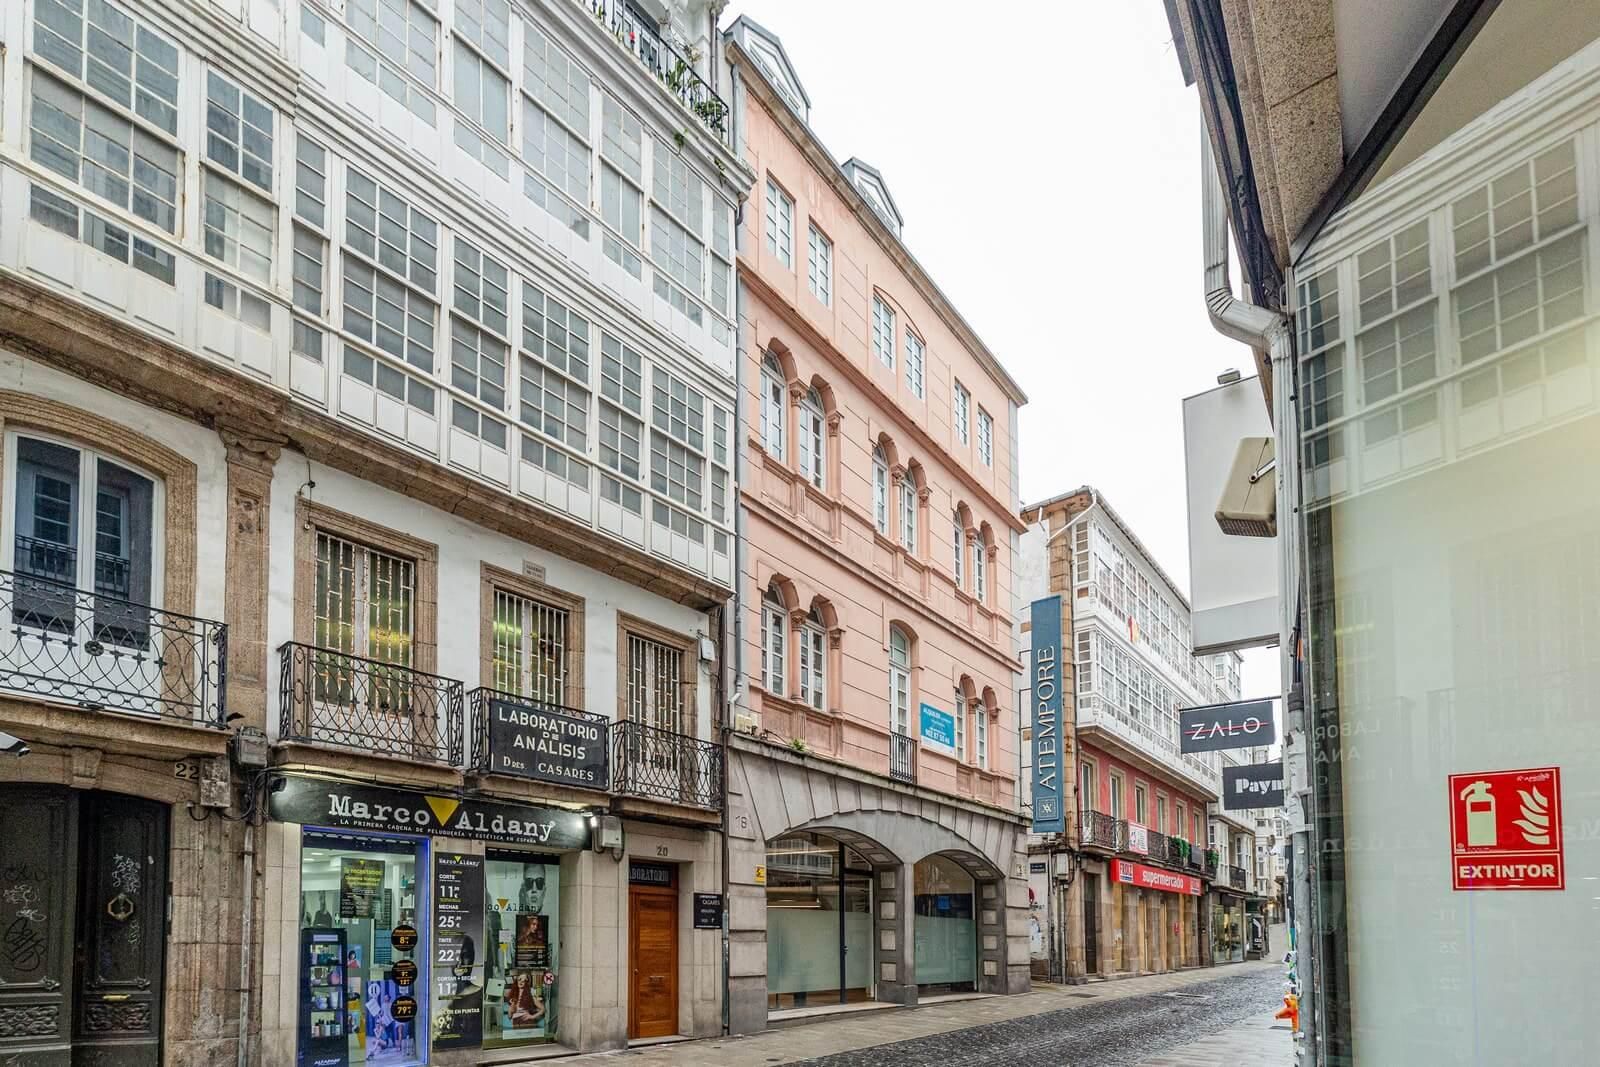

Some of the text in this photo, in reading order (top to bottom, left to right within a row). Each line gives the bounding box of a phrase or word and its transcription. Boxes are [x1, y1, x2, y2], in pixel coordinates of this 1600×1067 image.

[499, 706, 599, 740] LABORATORIO
[1037, 645, 1056, 791] ATEMPORE
[542, 731, 560, 741] DE
[1191, 717, 1261, 740] ZALO
[513, 734, 586, 760] ANALISIS
[175, 762, 200, 780] 22
[538, 762, 594, 781] CASARES
[327, 793, 557, 842] Marco Aldany
[340, 818, 349, 826] LA
[353, 819, 384, 829] PRIMERA
[656, 846, 669, 857] 20
[1142, 870, 1184, 889] supermercado
[1459, 864, 1555, 879] EXTINTOR
